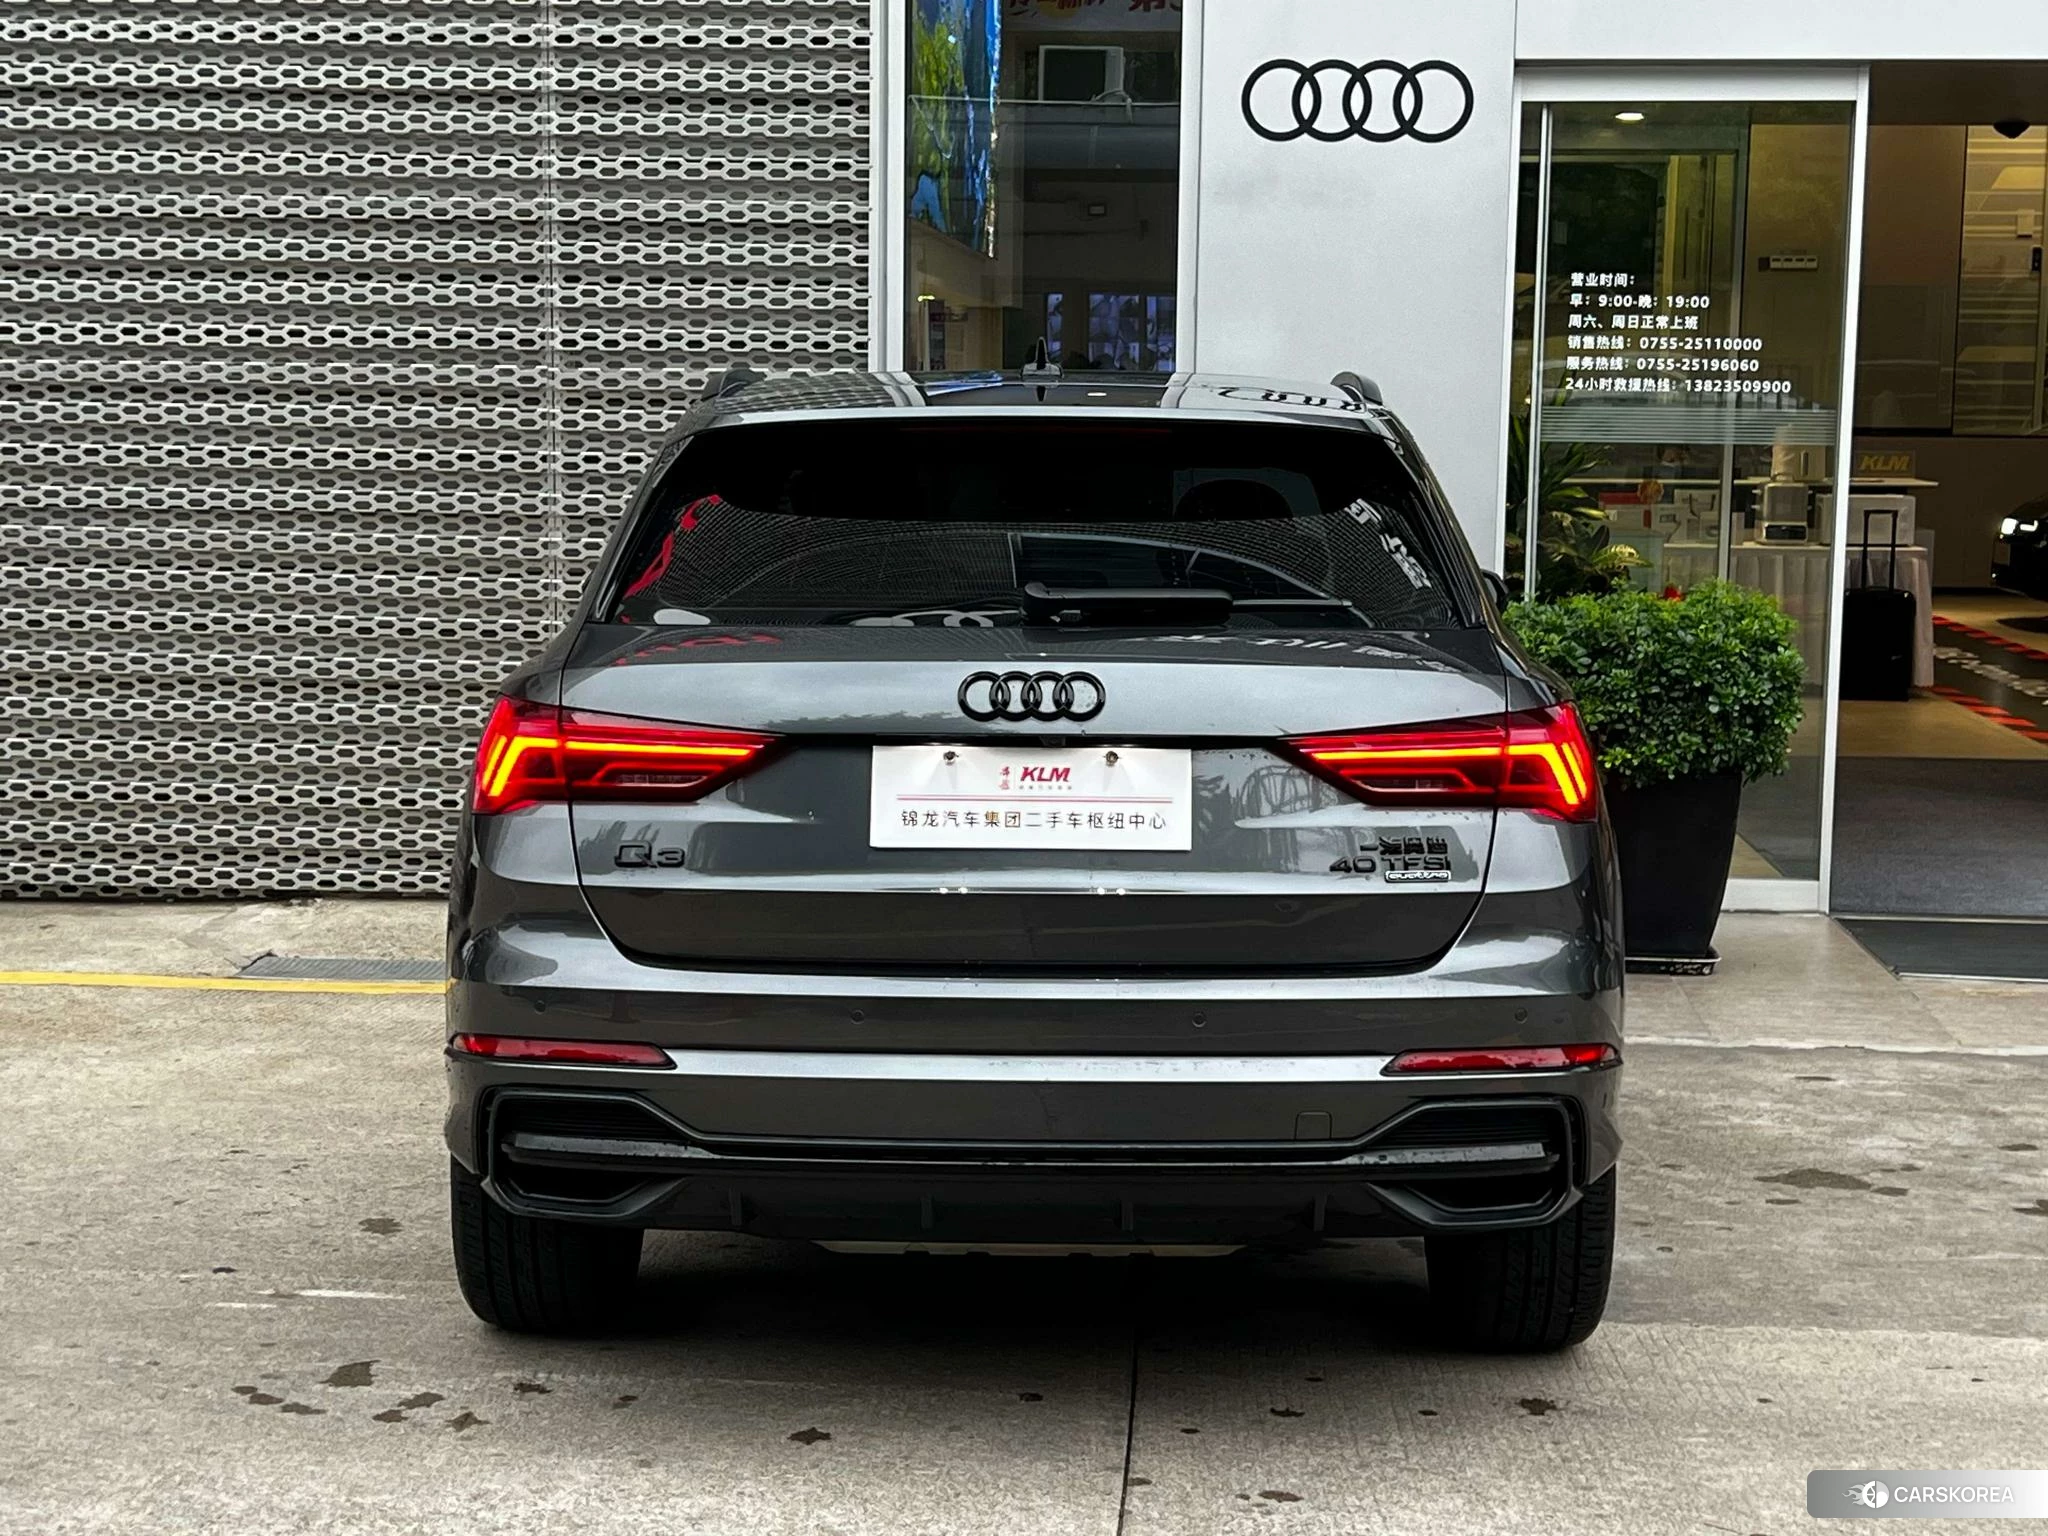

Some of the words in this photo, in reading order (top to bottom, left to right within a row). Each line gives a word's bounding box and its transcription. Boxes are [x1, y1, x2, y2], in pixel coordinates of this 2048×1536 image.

[1567, 314, 1699, 331] 周六、周日正常上班
[1859, 454, 1911, 472] KLM
[1020, 766, 1071, 782] KLM
[901, 810, 1167, 832] 锦龙汽车集团二手车枢纽中心
[614, 840, 686, 868] Q3
[1329, 855, 1377, 873] 40
[1381, 856, 1451, 871] TFSI
